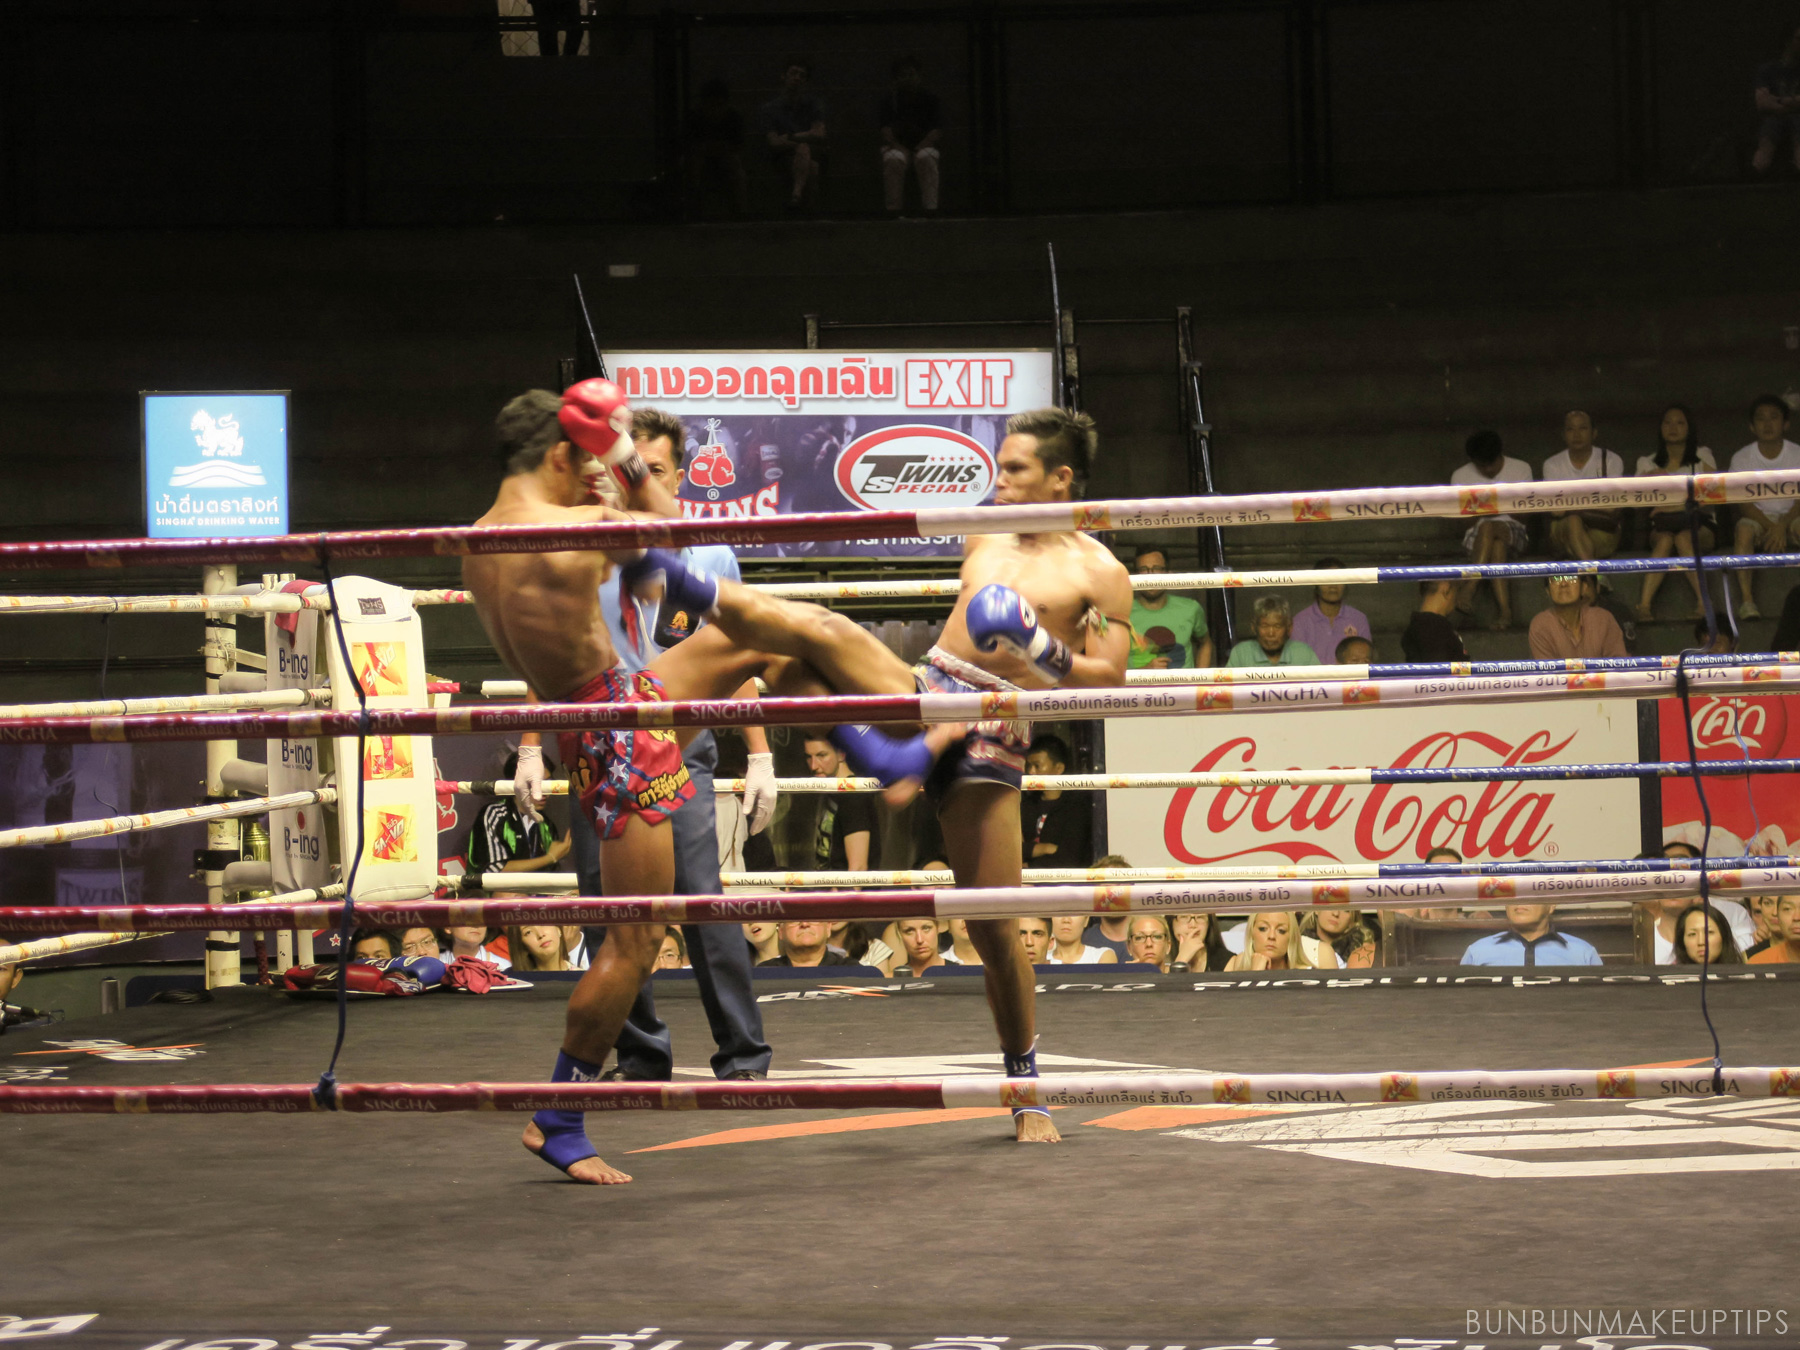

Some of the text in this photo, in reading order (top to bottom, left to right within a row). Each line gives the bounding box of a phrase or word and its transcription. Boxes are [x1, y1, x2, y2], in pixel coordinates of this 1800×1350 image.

[617, 358, 1012, 407] ทางออกฉุกเฉิน EXIT
[860, 455, 982, 483] TWINS
[860, 477, 967, 493] SPECIAL
[155, 494, 279, 513] น้ำดื่มตราสิงห์
[1345, 501, 1425, 517] SINGHA
[156, 517, 280, 526] SINGHA DRINKING WATER
[1252, 576, 1293, 584] SINGHA
[1595, 658, 1638, 668] SINGHA
[1245, 672, 1287, 680] SINGHA
[1029, 692, 1176, 711] เครื่องดื่มเกลือแร่ ซันโว
[1250, 687, 1329, 703] SINGHA
[690, 704, 765, 720] SINGHA
[1056, 780, 1095, 788] SINGHA
[1250, 777, 1291, 785] SINGHA
[284, 827, 319, 861] B-ing
[1306, 865, 1348, 875] SINGHA
[735, 878, 774, 886] SINGHA
[1141, 886, 1291, 906] เครื่องดื่มเกลือแร่ ซันโว
[1366, 883, 1446, 898] SINGHA
[710, 900, 785, 916] SINGHA
[1431, 1082, 1584, 1100] เครื่องดื่มเกลือแร่ ซันโว
[1660, 1078, 1740, 1095] SINGA
[721, 1094, 796, 1108] SINGHA
[1266, 1090, 1346, 1103] SINGHA
